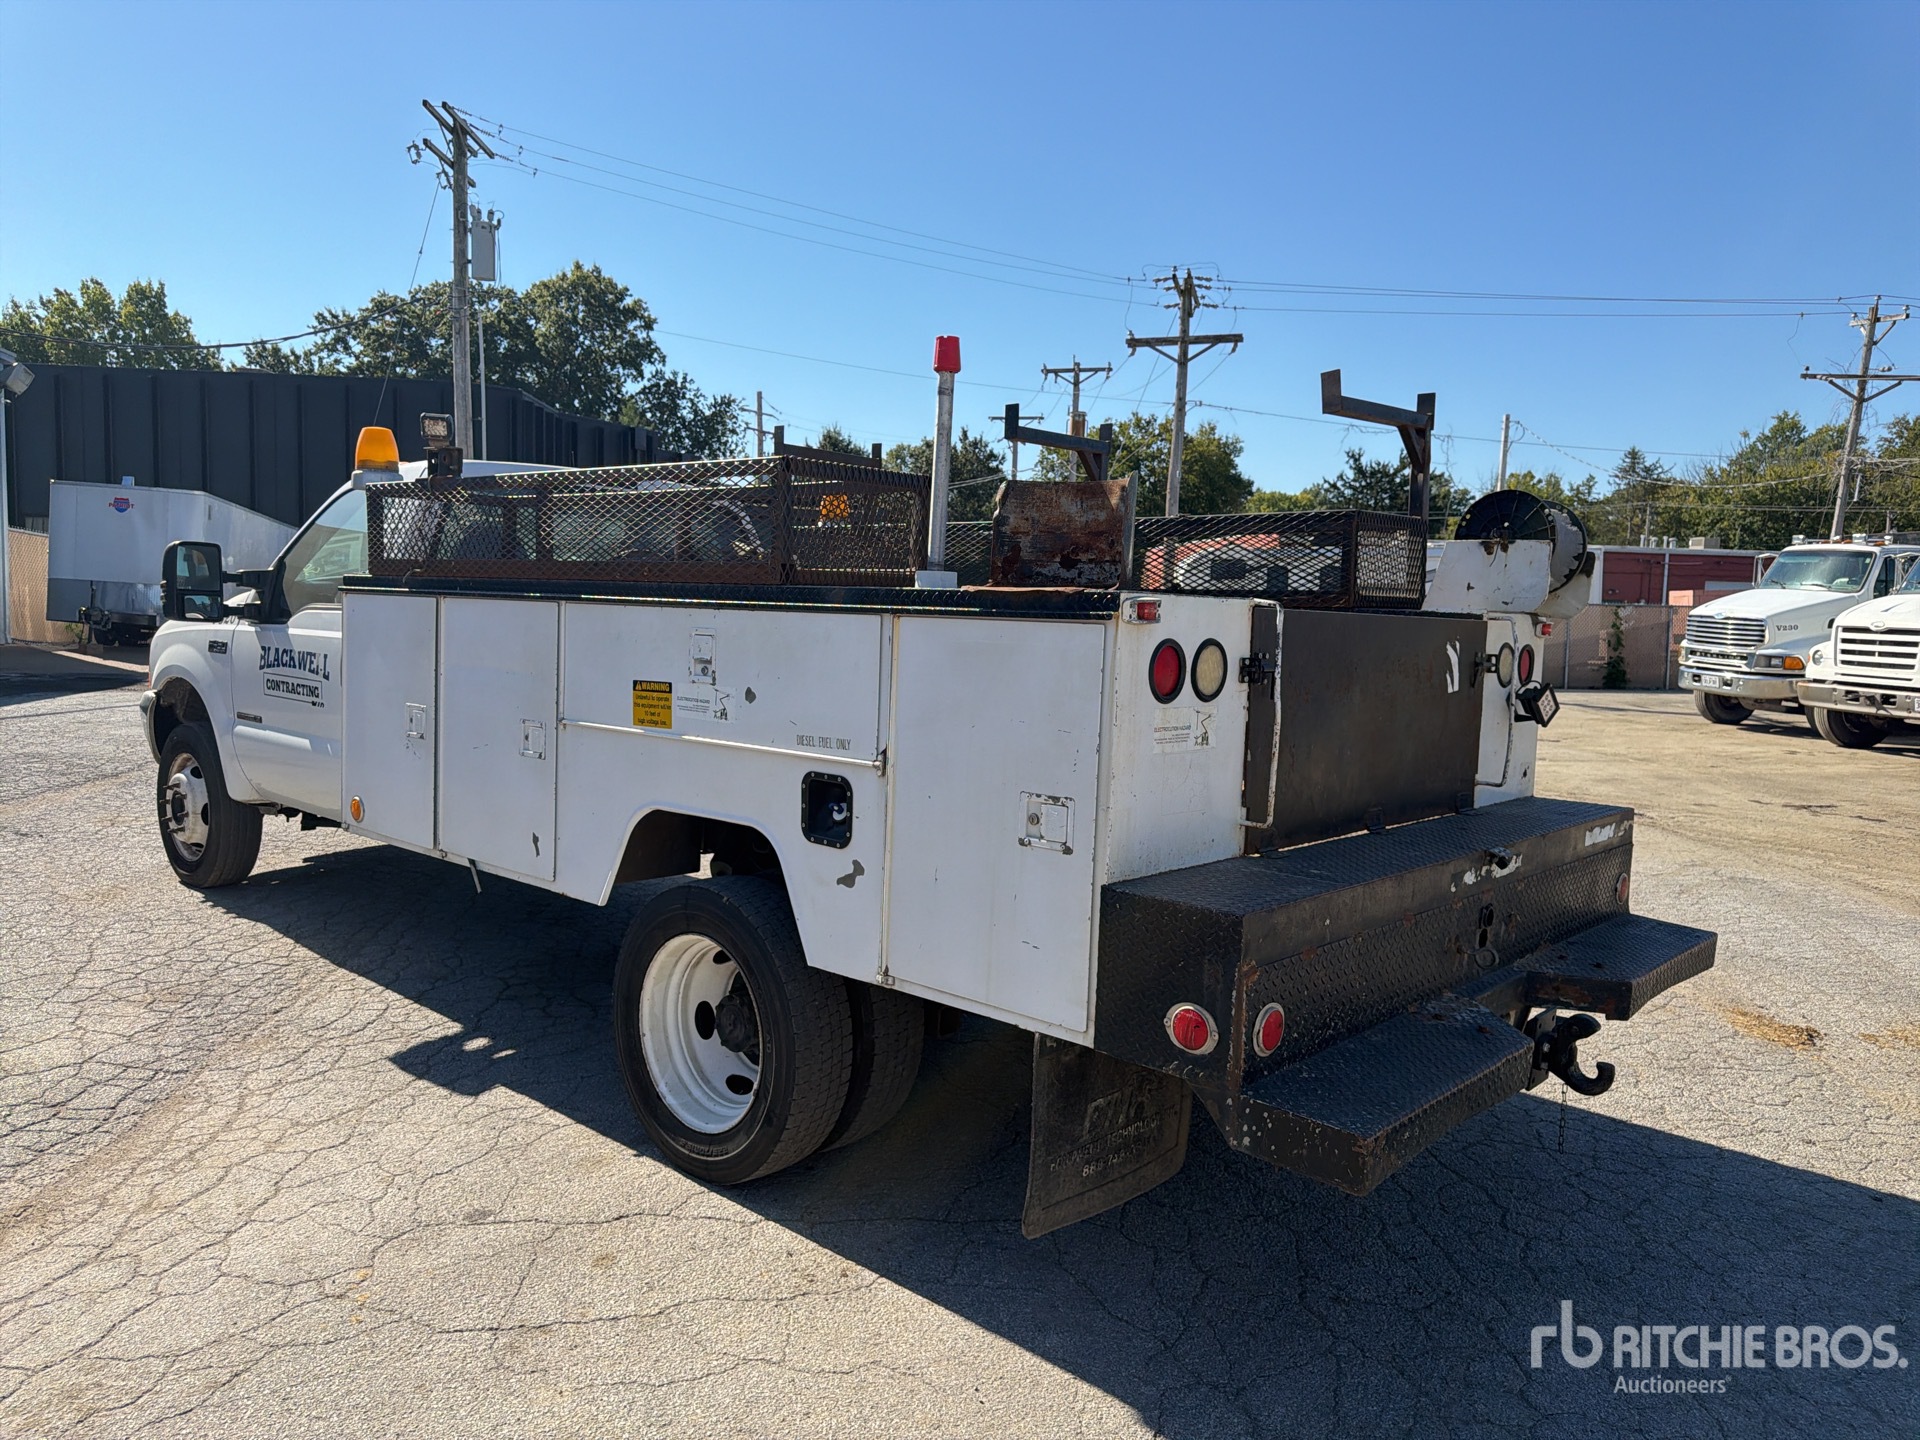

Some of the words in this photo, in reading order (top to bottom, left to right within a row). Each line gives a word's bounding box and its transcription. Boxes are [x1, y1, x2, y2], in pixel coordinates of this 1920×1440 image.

[266, 678, 320, 699] CONTRACTING
[641, 681, 670, 691] WARNING
[796, 734, 816, 747] DIESEL
[818, 736, 833, 749] FUEL
[836, 738, 851, 750] ONLY
